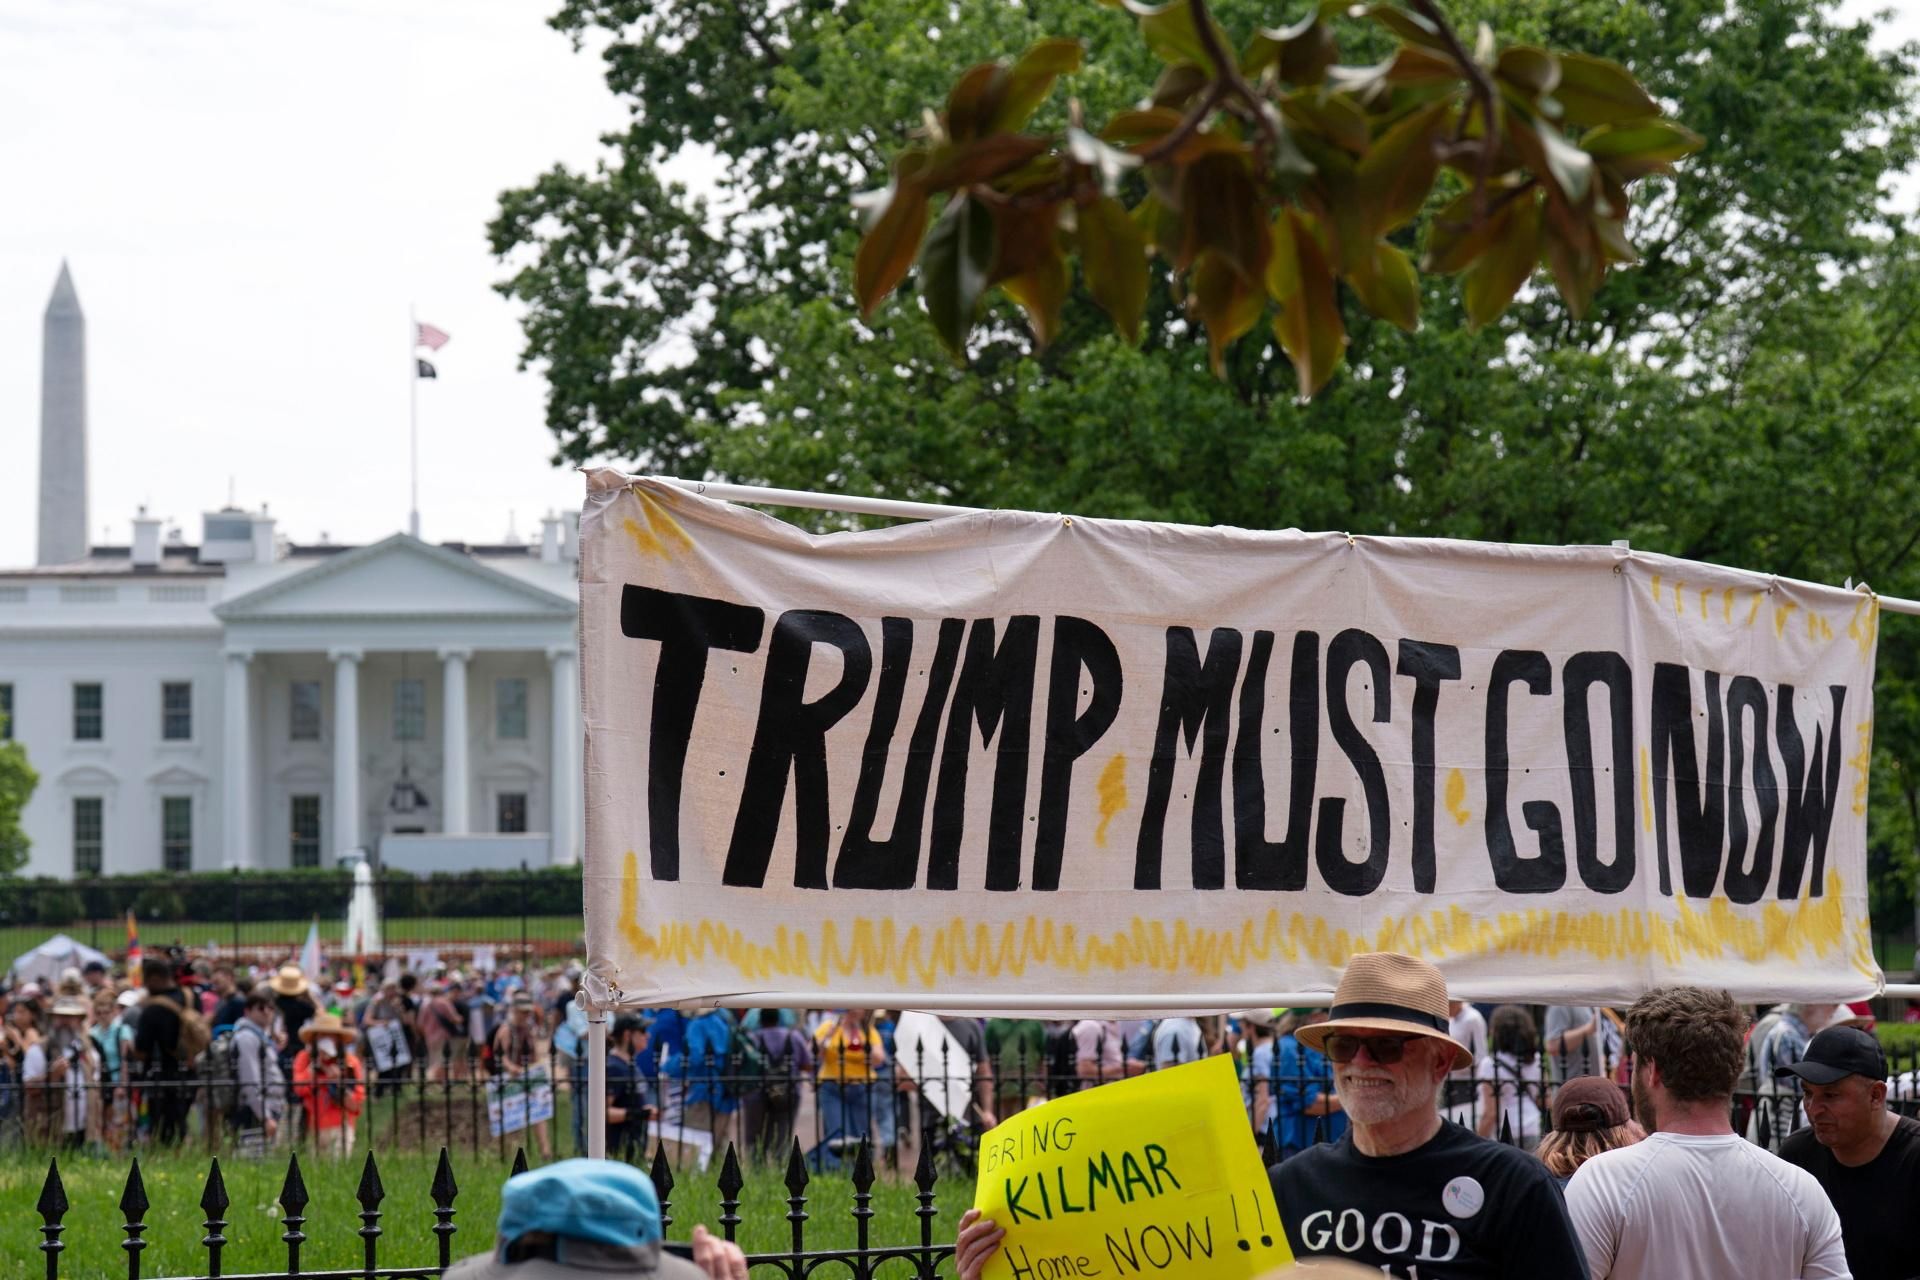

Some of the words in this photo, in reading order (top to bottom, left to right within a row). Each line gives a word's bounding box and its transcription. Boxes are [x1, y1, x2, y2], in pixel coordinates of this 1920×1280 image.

[620, 583, 1123, 892] TRUMP
[1134, 626, 1461, 896] MUST
[1485, 649, 1637, 895] GO
[1651, 662, 1846, 904] NOW
[986, 1117, 1077, 1173] BRING
[1005, 1143, 1182, 1224] KILMAR
[1003, 1244, 1101, 1280] Home
[1104, 1216, 1213, 1276] NOW
[1301, 1208, 1460, 1262] GOOD
